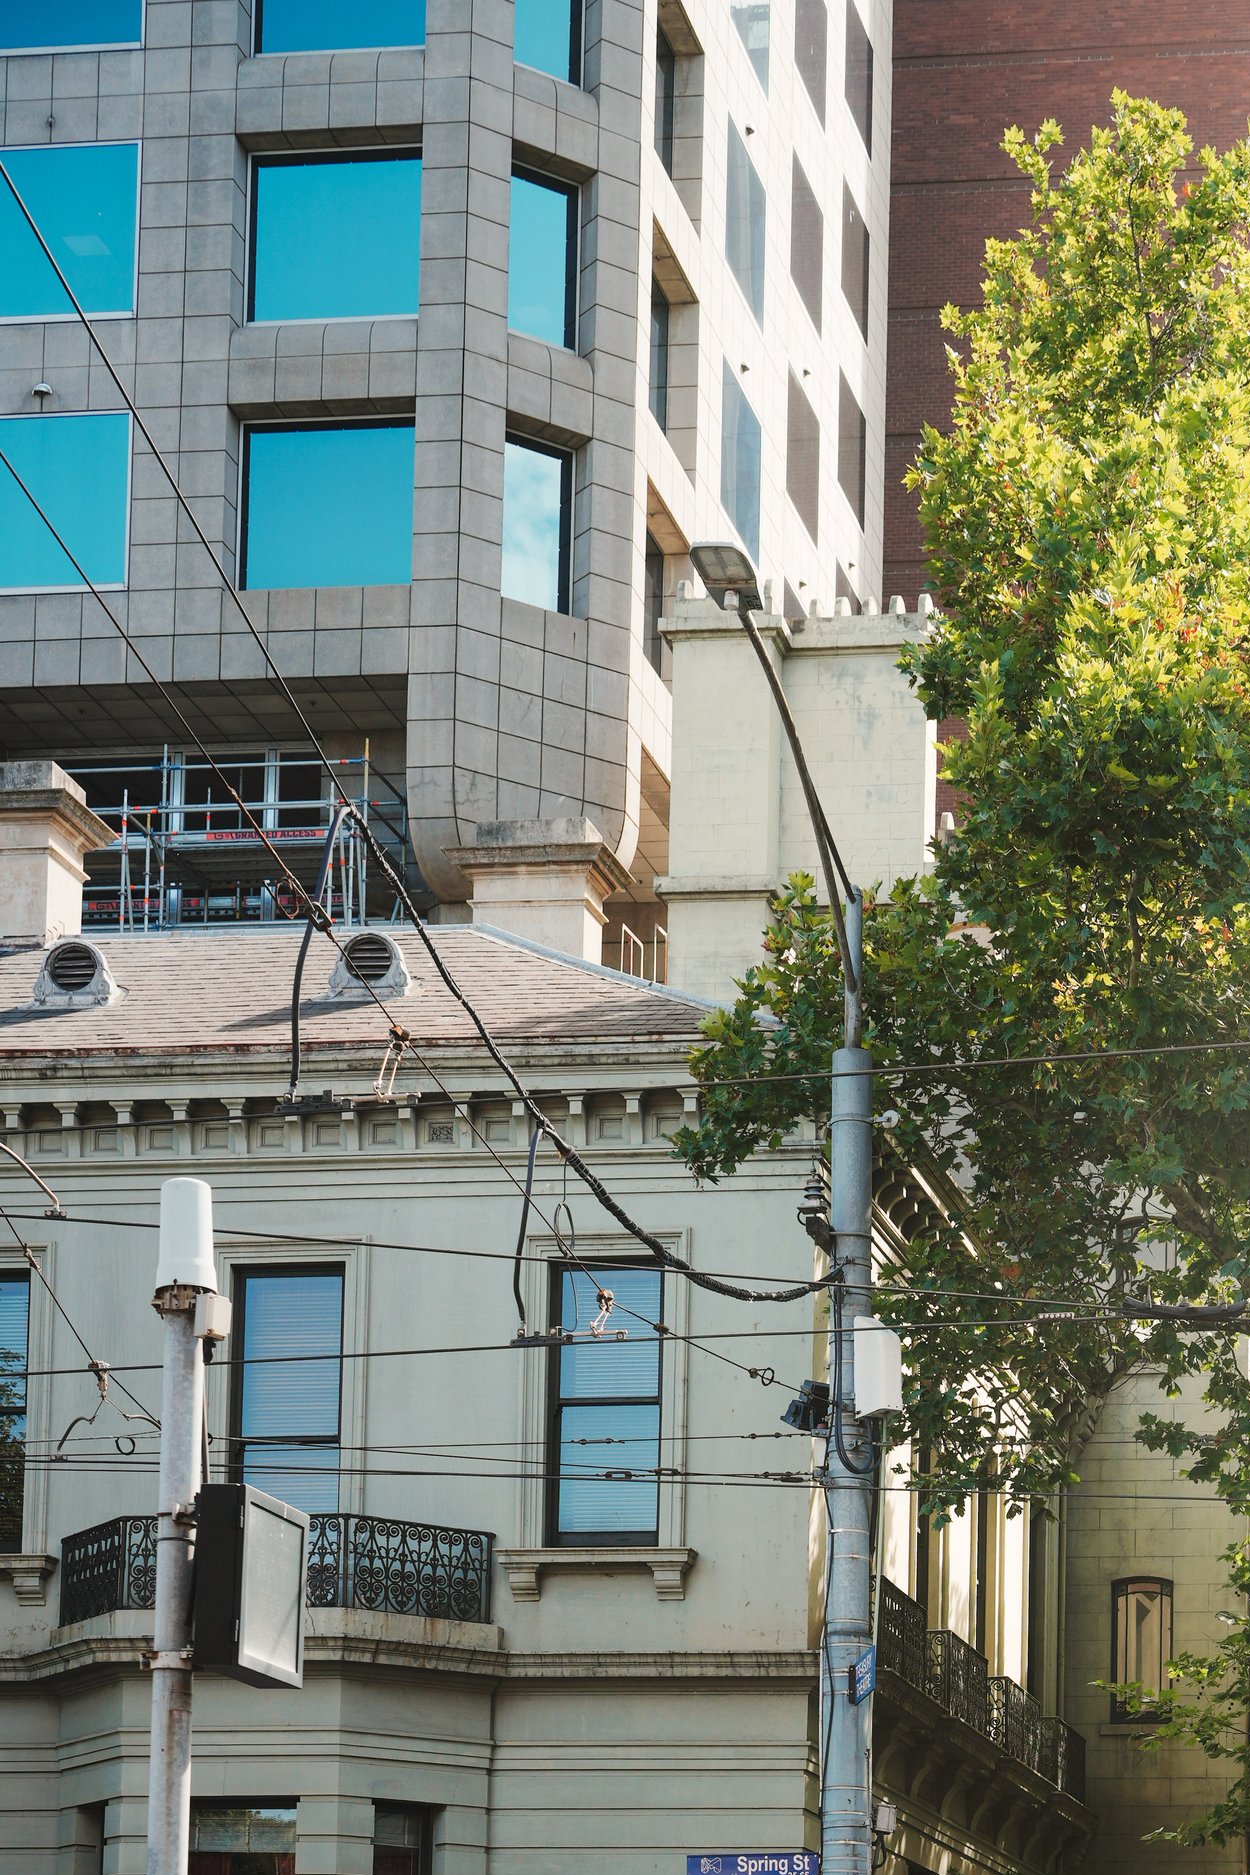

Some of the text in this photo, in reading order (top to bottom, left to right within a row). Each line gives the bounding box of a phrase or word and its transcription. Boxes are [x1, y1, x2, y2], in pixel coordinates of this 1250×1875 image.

[280, 829, 317, 838] ACCESS
[737, 1854, 810, 1875] Spring St
